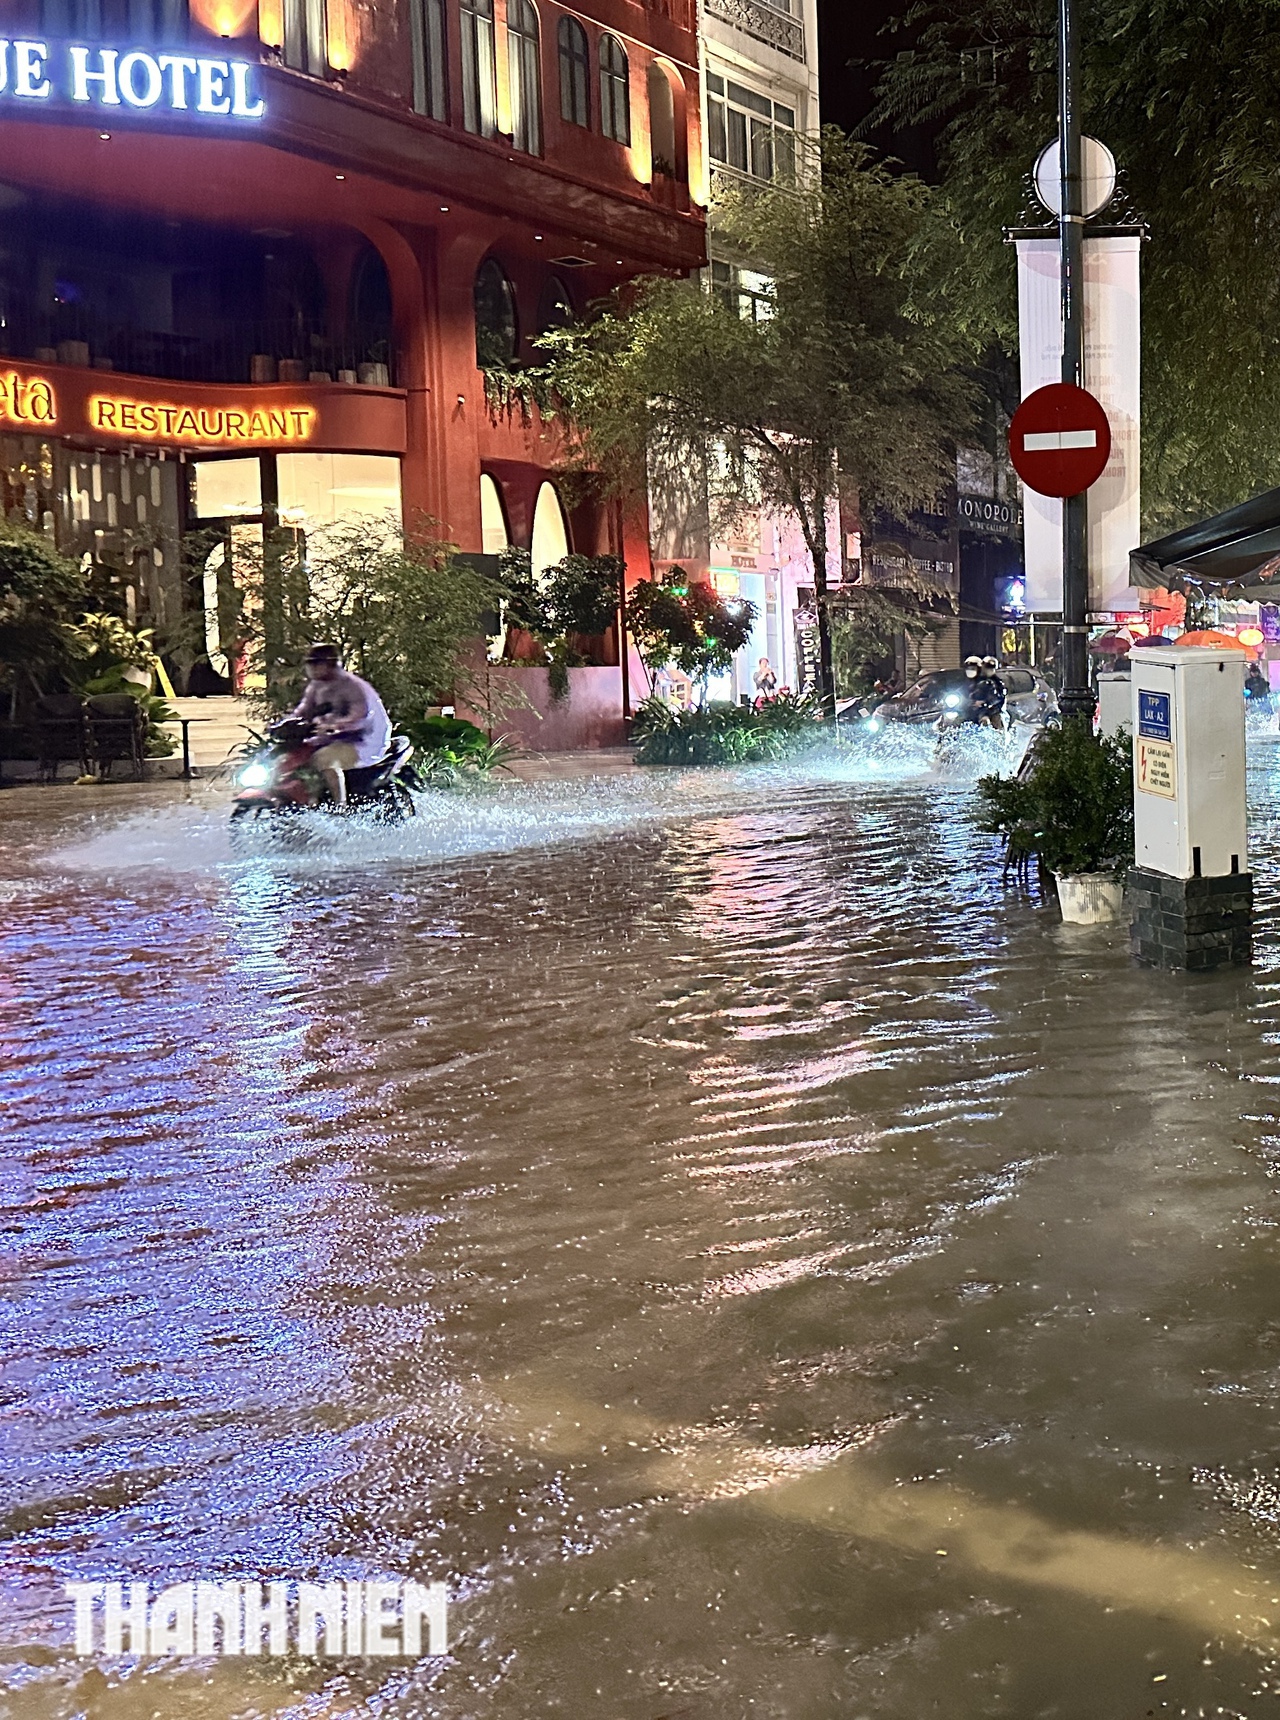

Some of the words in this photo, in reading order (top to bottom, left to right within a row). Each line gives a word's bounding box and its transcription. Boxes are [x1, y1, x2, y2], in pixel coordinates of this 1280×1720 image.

[0, 38, 50, 98] E
[70, 46, 265, 118] HOTEL
[97, 399, 310, 438] RESTAURANT
